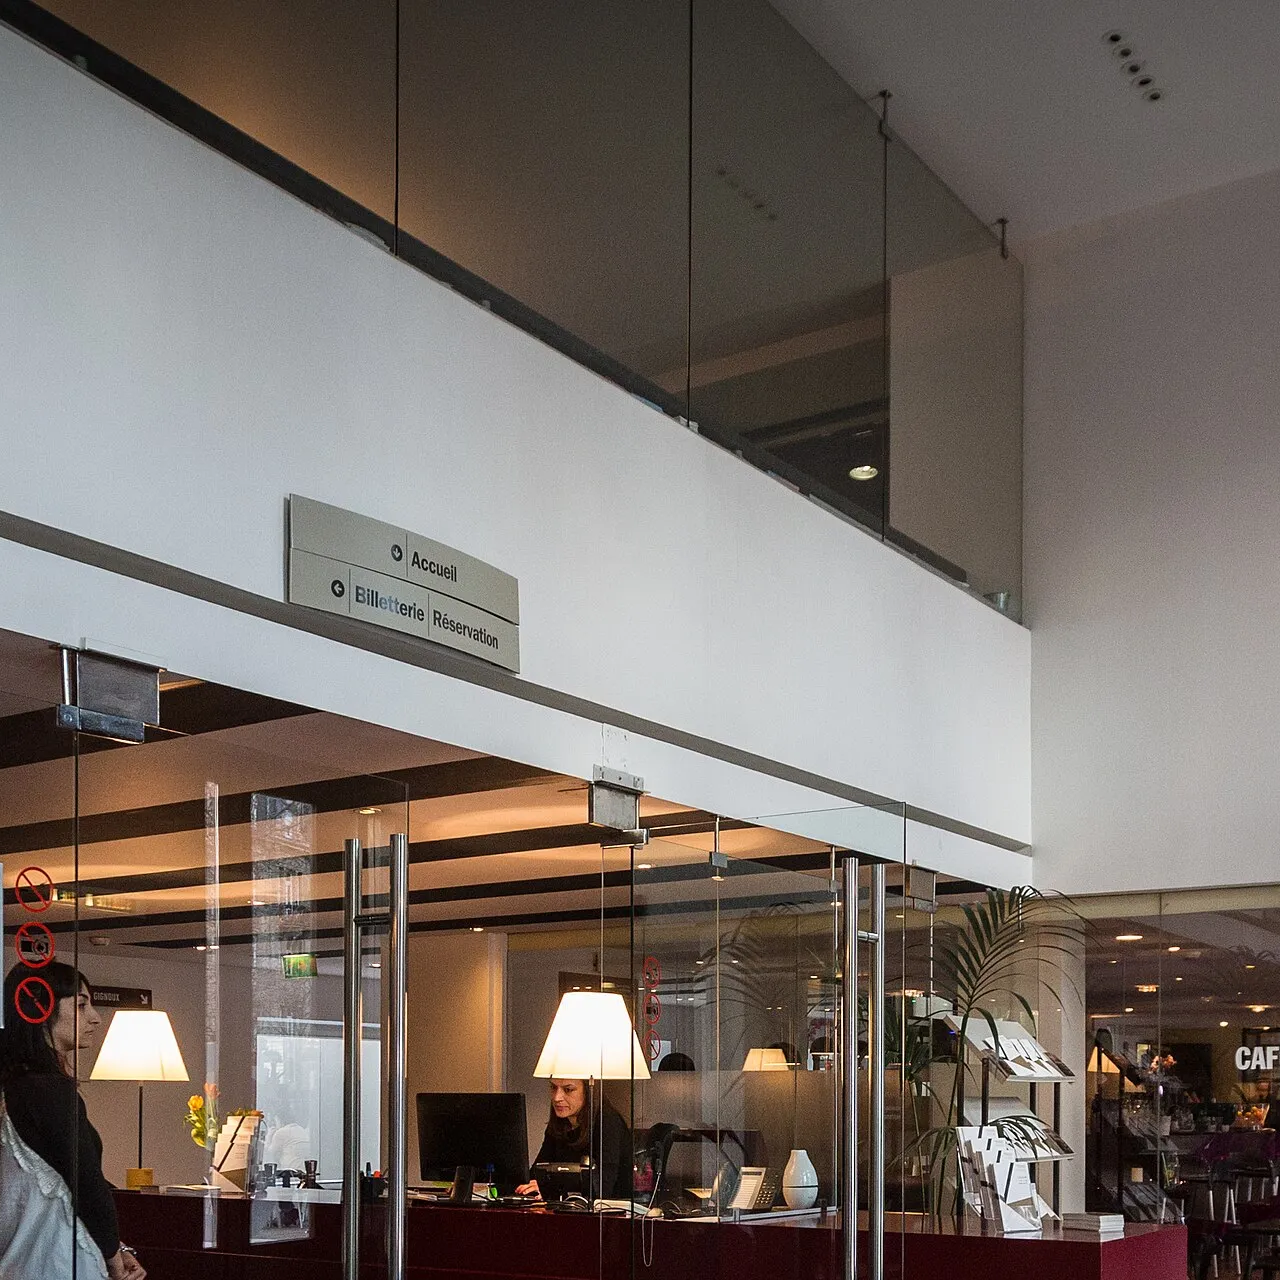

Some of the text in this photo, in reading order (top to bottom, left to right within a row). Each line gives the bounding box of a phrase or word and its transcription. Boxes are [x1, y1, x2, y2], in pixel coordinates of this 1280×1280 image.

[411, 551, 458, 582] Accueil
[355, 585, 499, 649] Billetterie Réservation
[93, 992, 120, 1002] GIGNOUX
